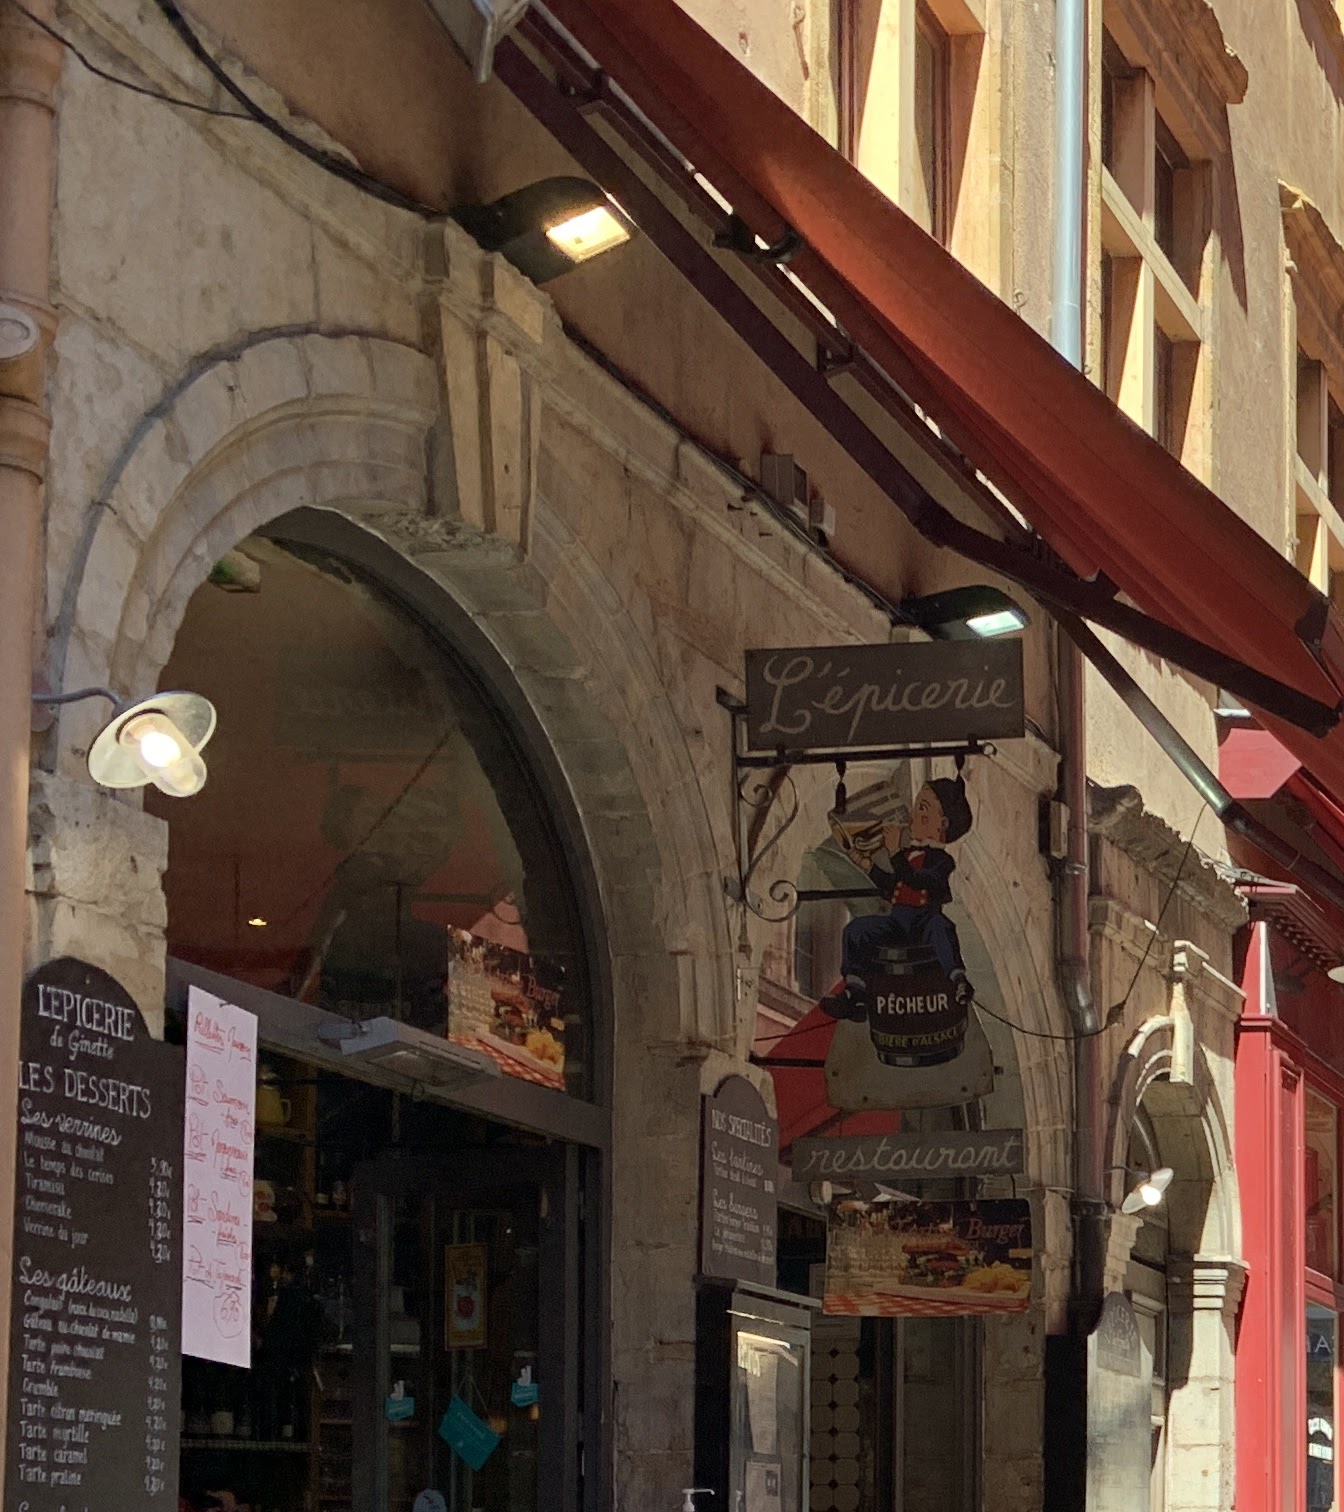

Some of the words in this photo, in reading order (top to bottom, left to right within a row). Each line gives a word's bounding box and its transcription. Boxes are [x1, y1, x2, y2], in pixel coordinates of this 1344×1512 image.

[758, 655, 1016, 743] L'épicerie
[876, 992, 949, 1015] PÊCHEUR
[50, 1024, 64, 1048] de
[68, 1029, 114, 1061] Ginette
[17, 1061, 55, 1094] LES
[64, 1067, 152, 1119] DESSERTS
[20, 1098, 54, 1128] Les
[55, 1114, 122, 1146] verrines
[712, 1109, 727, 1131] NOS
[24, 1151, 35, 1168] Le
[40, 1155, 66, 1177] temps
[802, 1134, 1022, 1175] restaurant
[965, 1217, 1025, 1249] Burger
[19, 1255, 52, 1287] Les
[56, 1265, 132, 1303] gâteaux
[21, 1354, 45, 1374] Tarte
[20, 1398, 46, 1417] Tarte
[19, 1420, 46, 1439] Tarte
[19, 1442, 47, 1462] Tarte
[18, 1464, 46, 1483] Tarte
